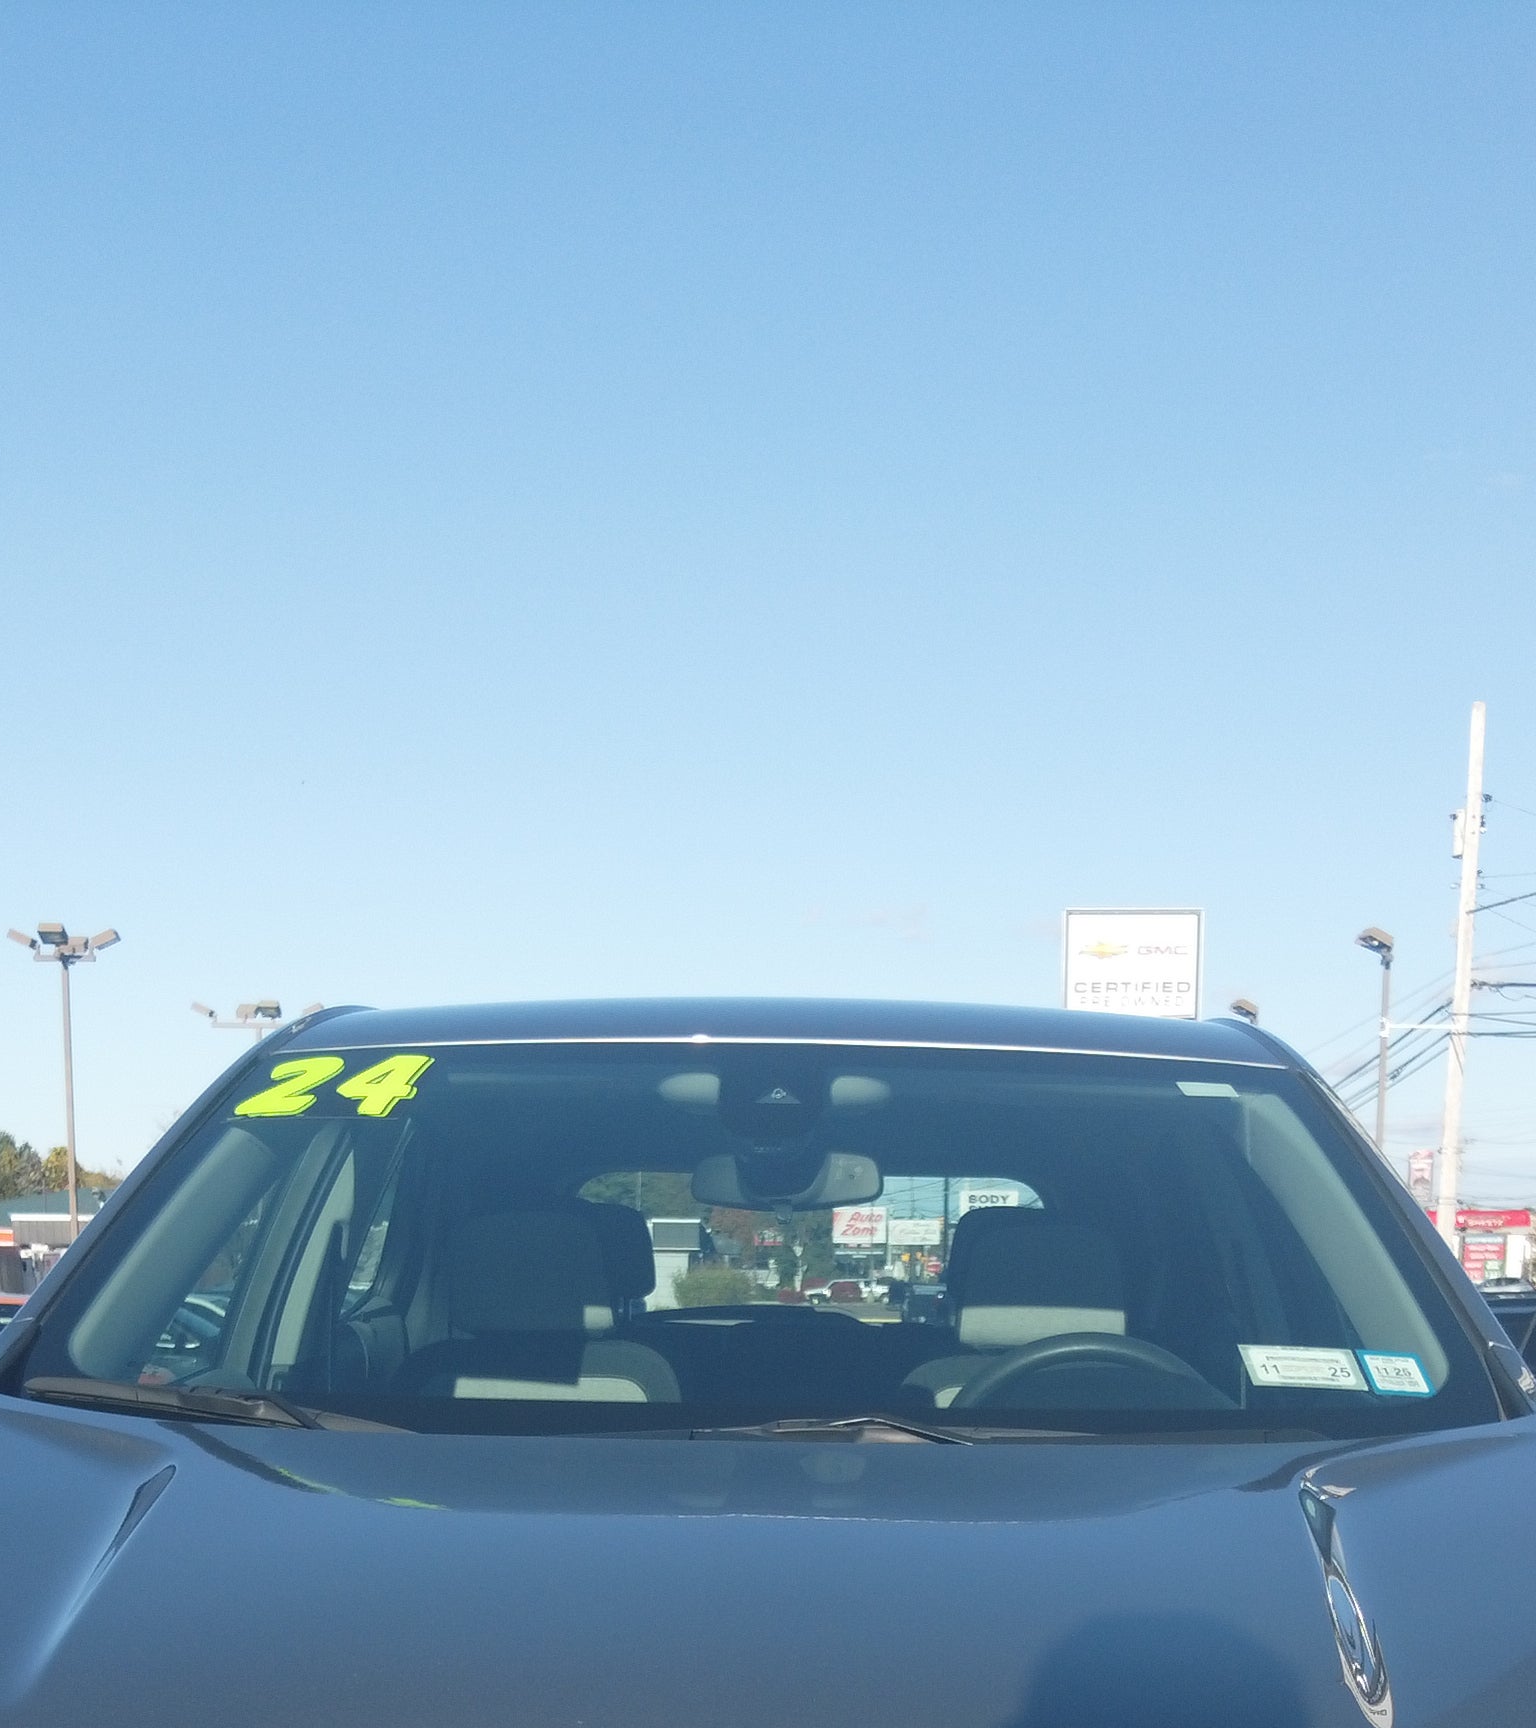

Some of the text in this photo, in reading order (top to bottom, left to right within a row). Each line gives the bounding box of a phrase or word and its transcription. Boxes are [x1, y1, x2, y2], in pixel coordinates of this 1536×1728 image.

[1136, 945, 1189, 956] GMC
[1073, 981, 1192, 993] CERTIFIED
[233, 1054, 437, 1118] 24
[967, 1194, 1010, 1204] BODY
[849, 1211, 884, 1224] Auto
[840, 1224, 878, 1237] Zone
[1260, 1363, 1352, 1378] 11 25
[1394, 1367, 1412, 1378] 25
